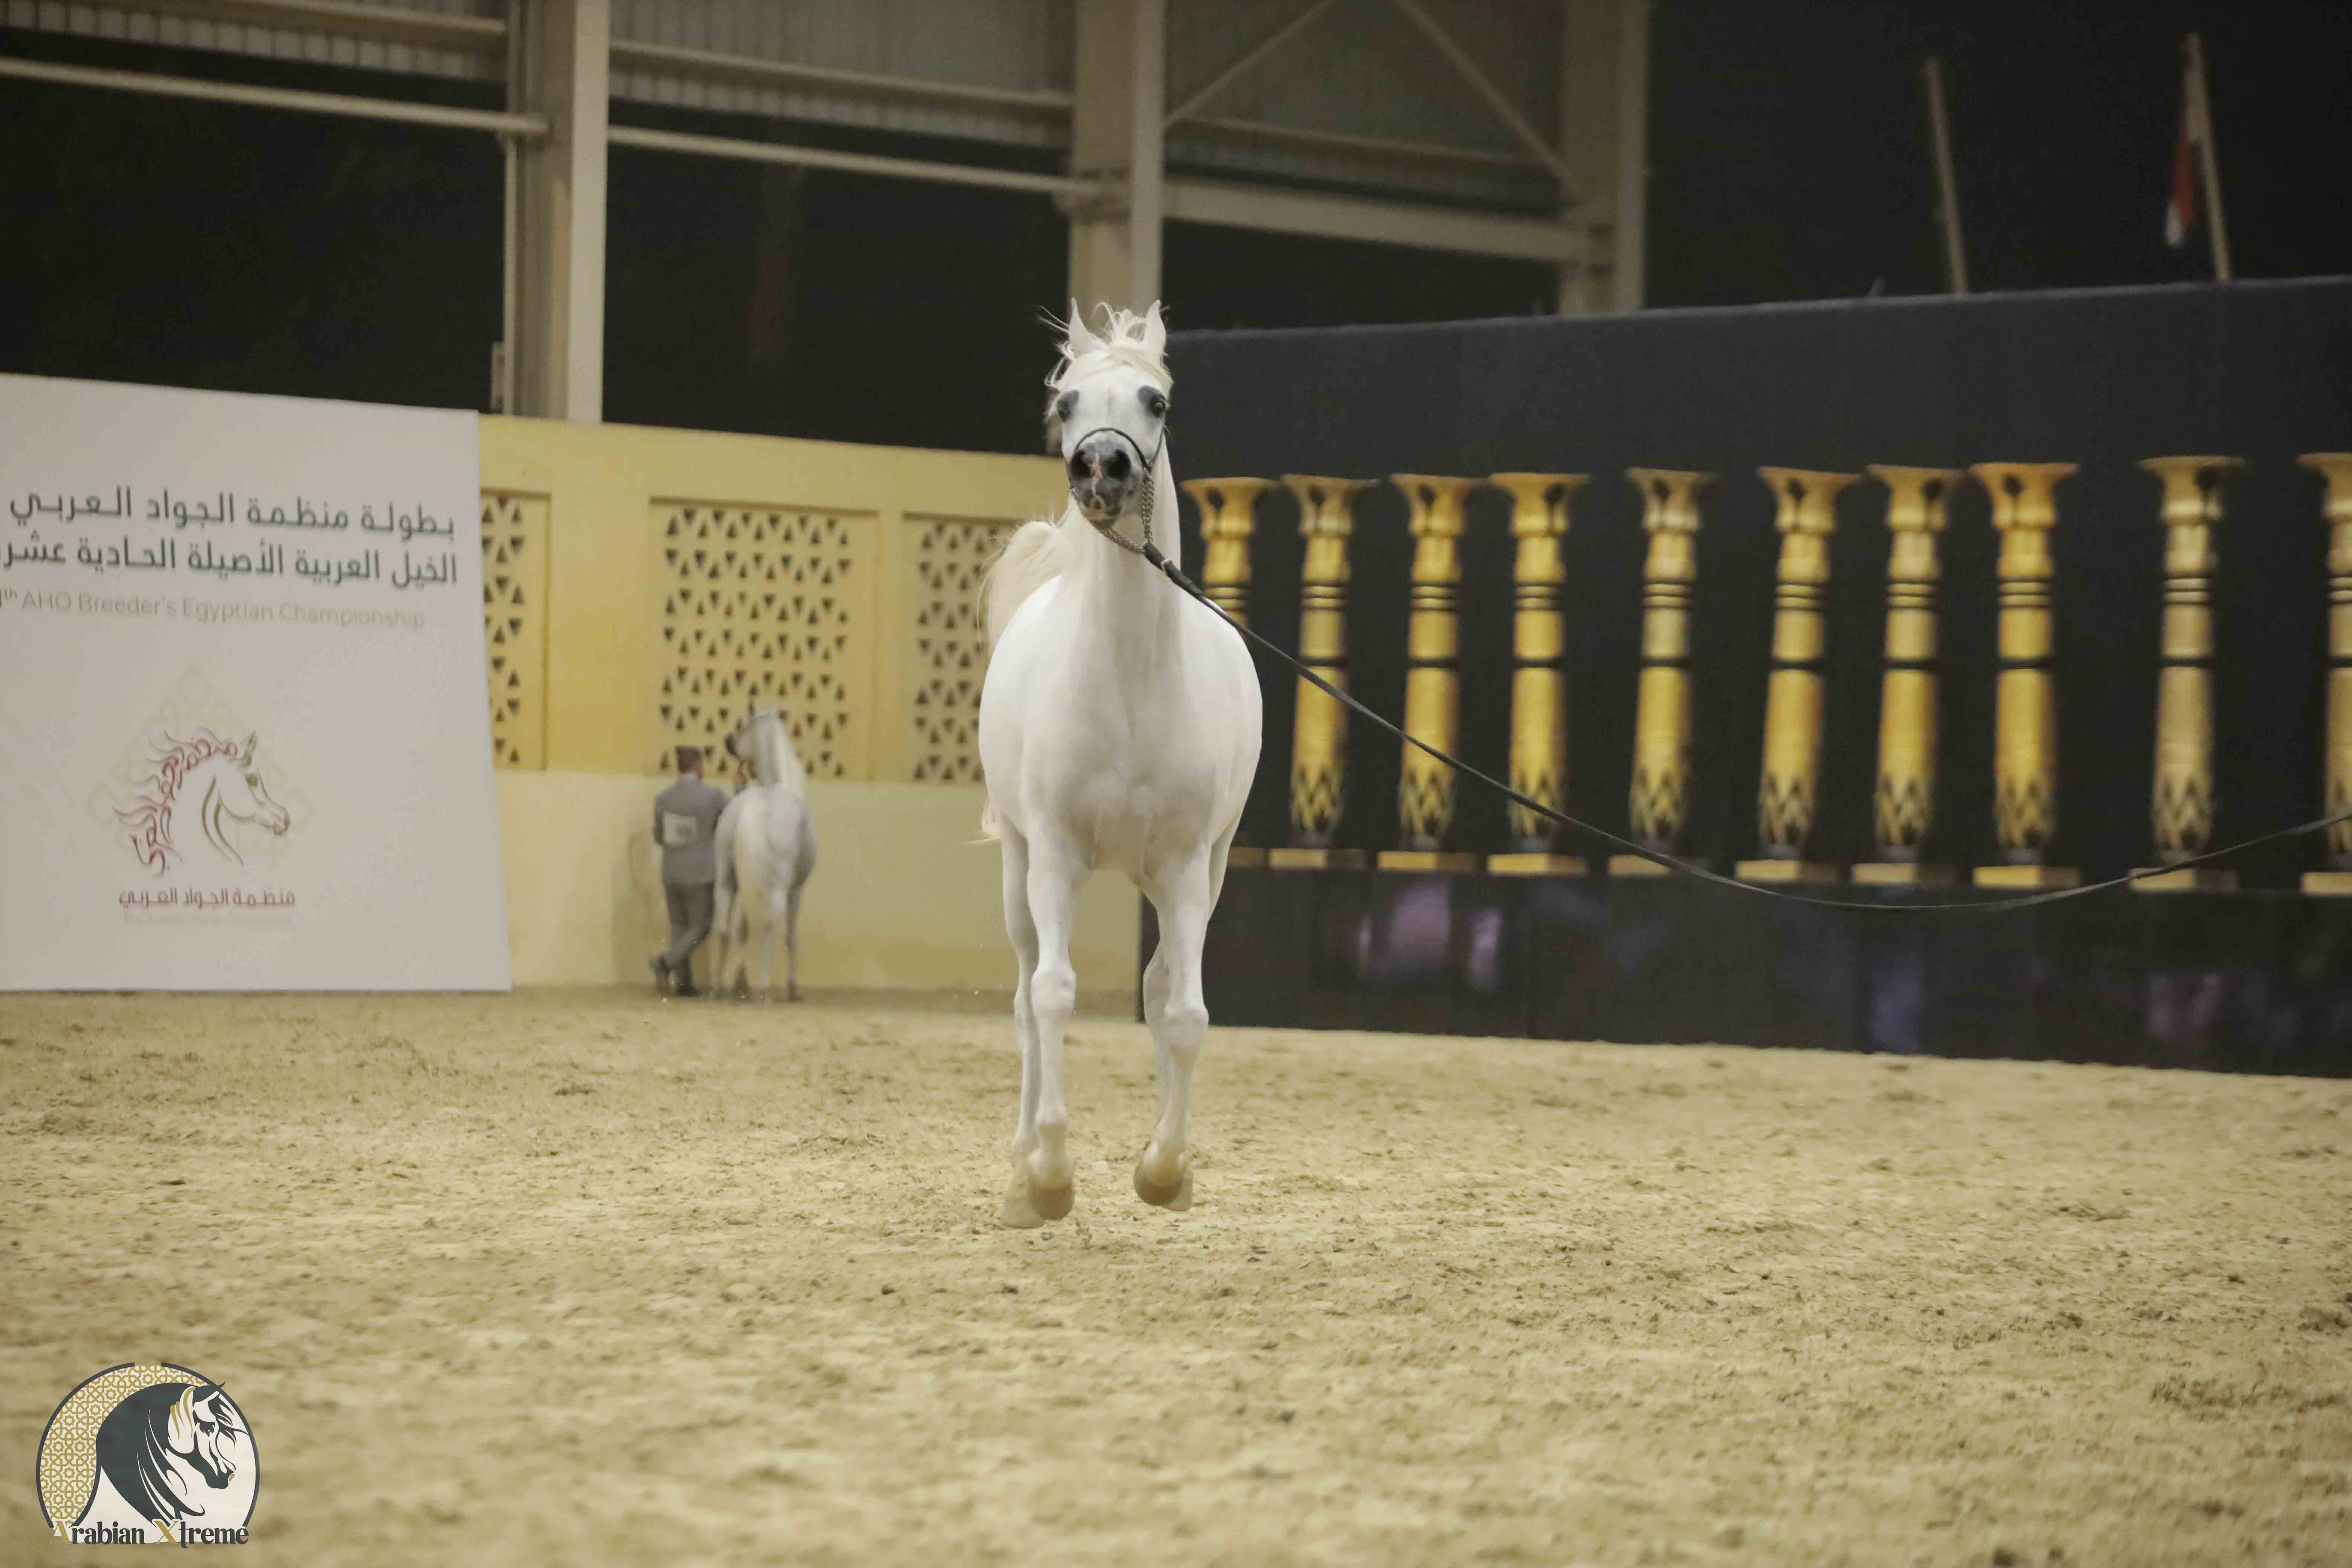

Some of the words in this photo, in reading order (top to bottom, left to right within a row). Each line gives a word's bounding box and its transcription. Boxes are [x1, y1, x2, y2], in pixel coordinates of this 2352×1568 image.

[10, 485, 132, 527] العربي
[146, 487, 234, 530] الجواد
[247, 495, 349, 527] منظمة
[361, 501, 454, 542] بطولة
[0, 528, 66, 567] عشر
[77, 535, 176, 574] الحادية
[188, 537, 283, 579] الأصيلة
[295, 548, 380, 584] العربية
[392, 550, 457, 589] الخيل
[21, 590, 72, 612] AHO
[78, 591, 177, 617] Breeder's
[182, 596, 274, 623] Egyptian
[279, 602, 426, 629] Championship
[119, 886, 178, 909] العربي
[182, 886, 229, 909] الجواد
[233, 886, 296, 906] منظمة
